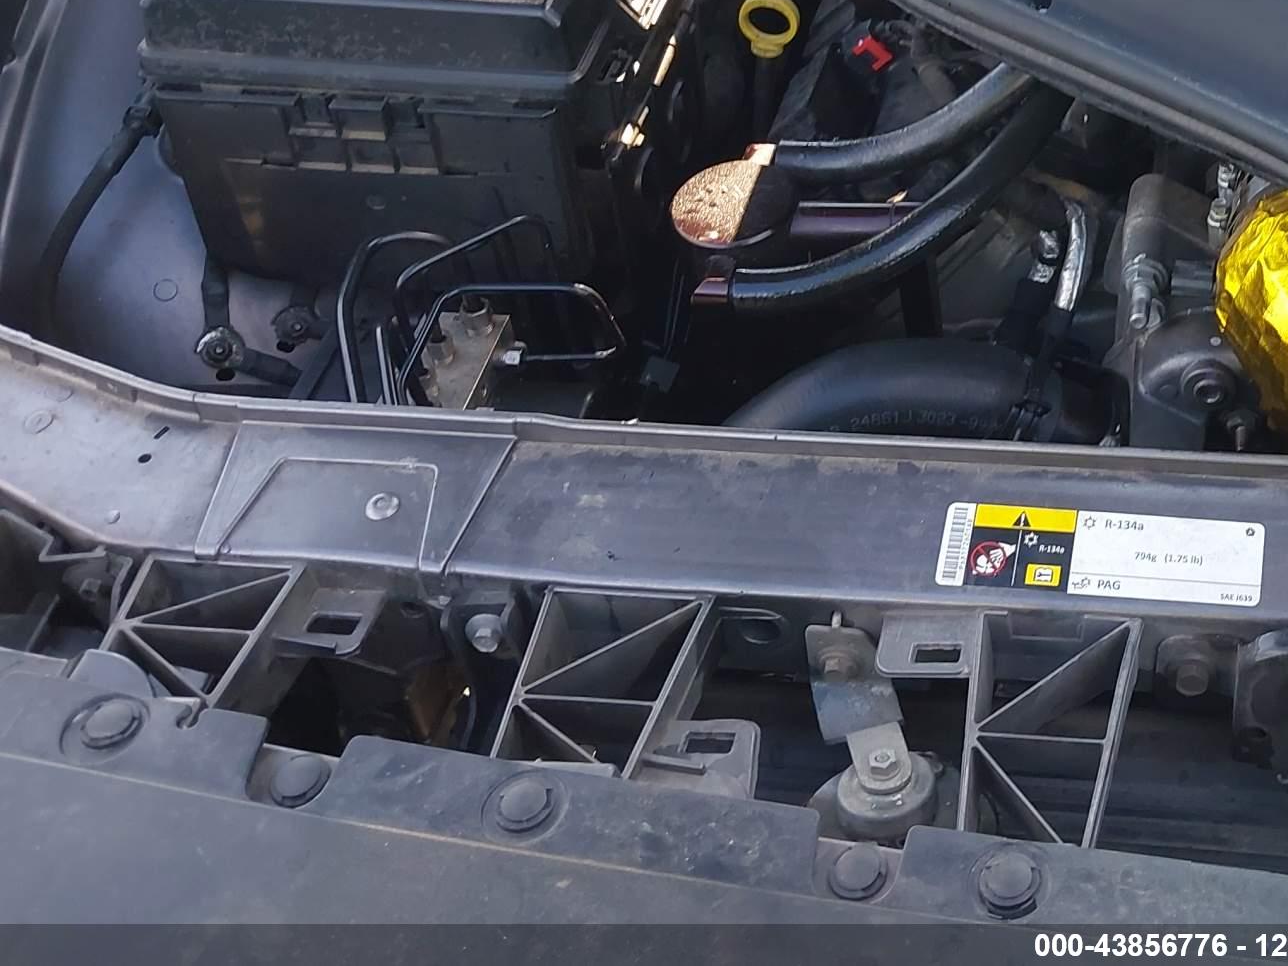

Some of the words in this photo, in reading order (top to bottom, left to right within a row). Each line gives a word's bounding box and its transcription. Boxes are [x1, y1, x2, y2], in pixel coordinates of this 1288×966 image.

[1104, 519, 1144, 532] R-134a
[1134, 551, 1157, 563] 794g
[1164, 553, 1188, 564] (1.75
[1190, 554, 1204, 566] lb)
[1097, 579, 1121, 591] PAG
[1220, 593, 1234, 601] SAE
